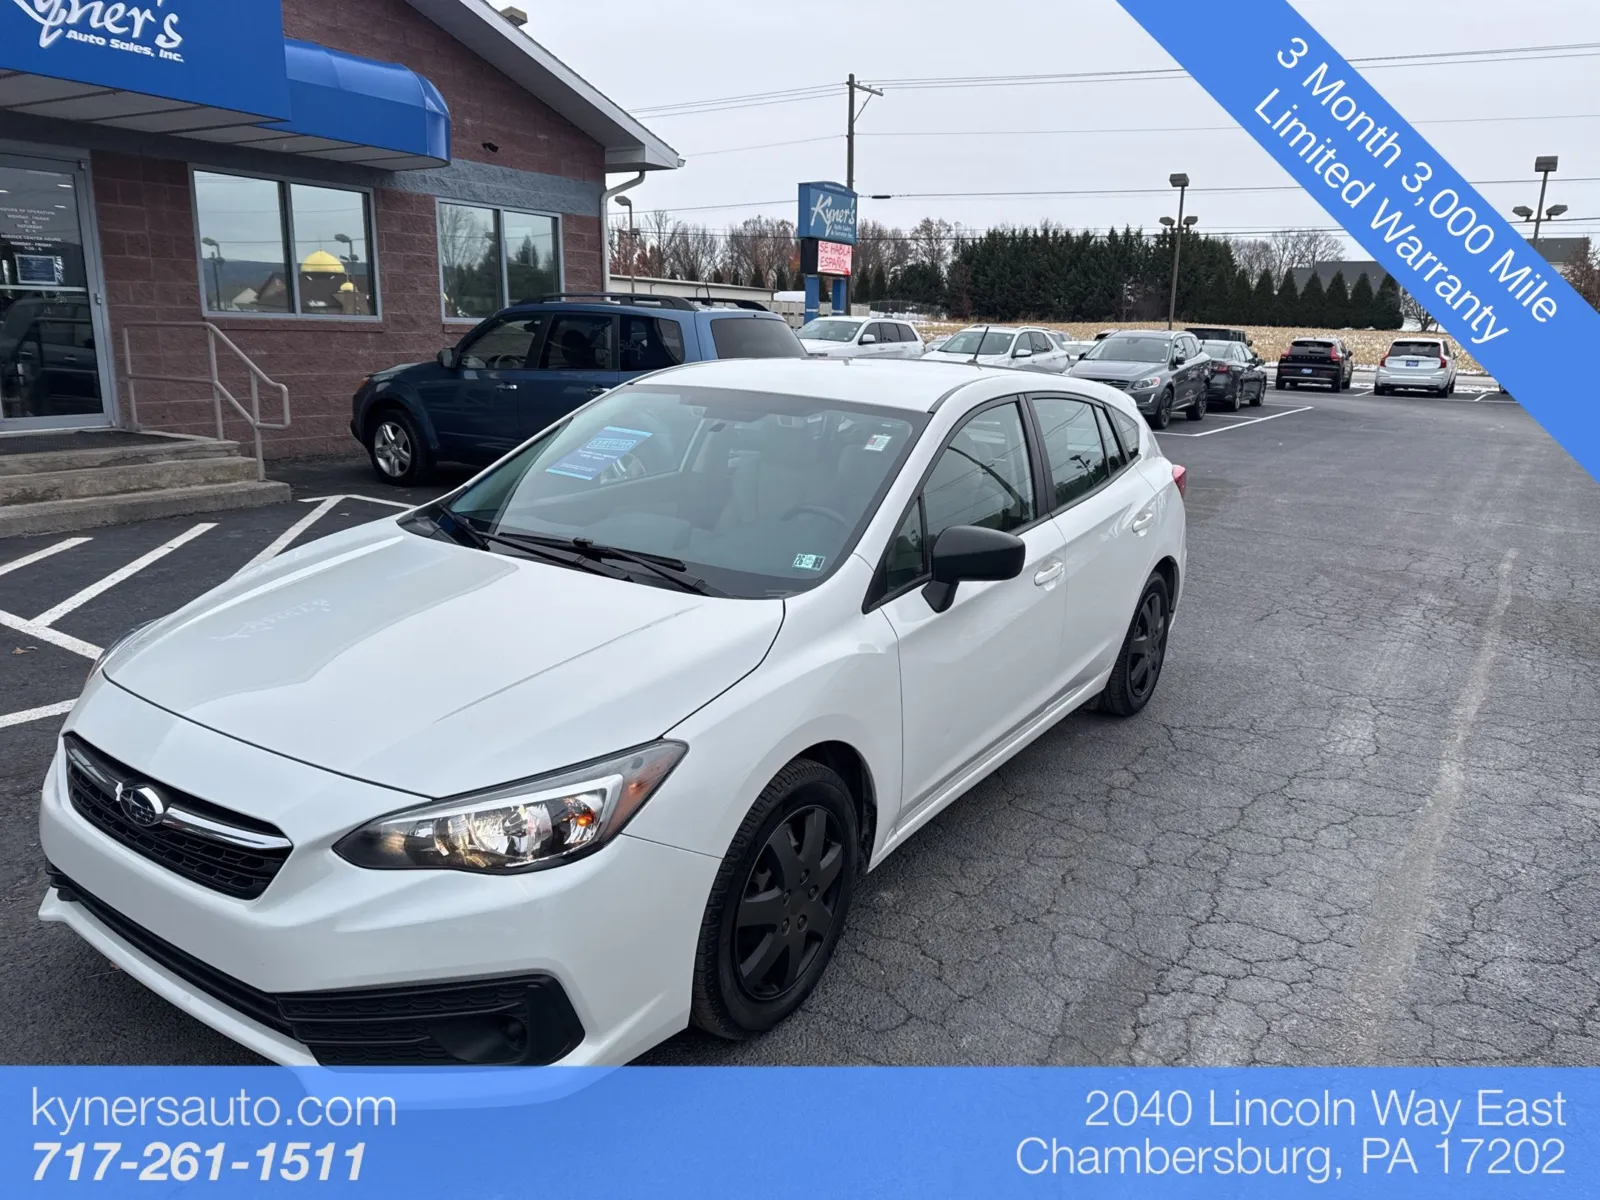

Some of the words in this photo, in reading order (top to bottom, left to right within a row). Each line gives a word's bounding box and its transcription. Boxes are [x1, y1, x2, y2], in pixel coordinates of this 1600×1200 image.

[66, 29, 106, 46] Auto
[109, 38, 155, 57] Sales,
[158, 48, 184, 62] Inc.
[811, 194, 855, 237] Kyner's
[820, 242, 829, 253] SE
[830, 244, 850, 256] HABLA
